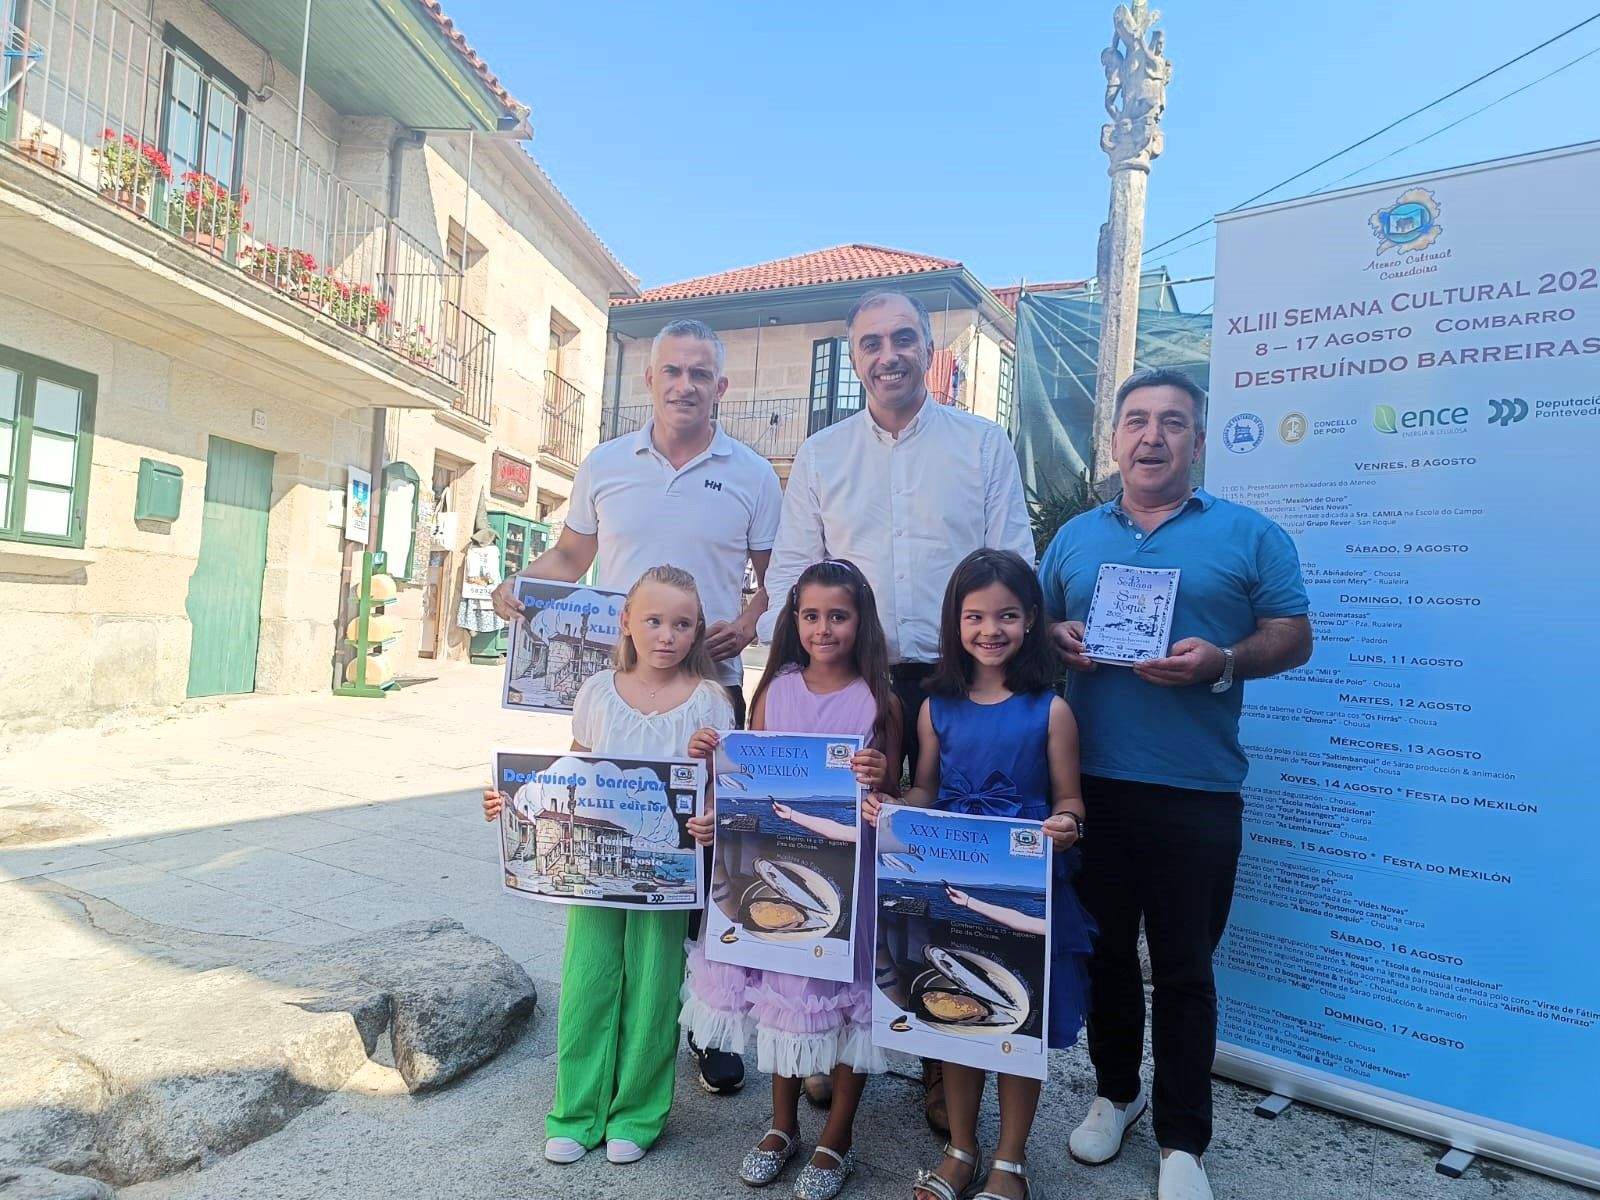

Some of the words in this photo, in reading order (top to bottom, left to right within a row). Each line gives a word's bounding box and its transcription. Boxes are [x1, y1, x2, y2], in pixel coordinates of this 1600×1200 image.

[1362, 260, 1401, 271] Ateneo
[1405, 249, 1452, 265] Cultural
[1379, 265, 1438, 281] Corredoira
[1227, 311, 1278, 335] XLIII
[1284, 300, 1384, 327] SEMANA
[1390, 280, 1531, 312] CULTURAL
[1537, 268, 1598, 294] 202
[1255, 343, 1268, 356] 8
[1296, 335, 1319, 350] 17
[1324, 326, 1412, 348] AGOSTO
[1435, 308, 1575, 333] COMBARRO
[1235, 355, 1408, 389] DESTRUÍNDO
[1417, 337, 1600, 368] BARREIRAS
[1535, 395, 1600, 411] Deputació
[1313, 418, 1357, 428] CONCELLO
[1401, 406, 1469, 428] ence
[1325, 427, 1346, 435] POIO
[1354, 461, 1408, 471] VENRES,
[1411, 459, 1420, 468] 8
[1423, 457, 1476, 467] AGOSTO
[704, 479, 722, 491] HH
[1372, 509, 1403, 517] CAMILA
[1415, 508, 1440, 516] Escola
[1403, 543, 1412, 552] 9
[1415, 543, 1469, 553] AGOSTO
[1116, 590, 1139, 602] San
[1340, 594, 1402, 605] DOMINGO,
[1407, 595, 1424, 605] 10
[1426, 597, 1481, 606] AGOSTO
[589, 624, 618, 634] XLII
[1349, 653, 1387, 664] LUNS,
[1391, 655, 1406, 665] 11
[1410, 657, 1464, 668] AGOSTO
[1339, 693, 1394, 706] MARTES,
[1399, 698, 1415, 708] 12
[1418, 700, 1472, 712] AGOSTO
[740, 745, 768, 757] XXX
[771, 747, 809, 759] FESTA
[1329, 736, 1402, 752] MÉRCORES,
[1408, 744, 1425, 754] 13
[1427, 747, 1482, 760] AGOSTO
[740, 763, 755, 774] DO
[758, 764, 809, 777] MEXILÓN
[595, 775, 668, 792] barreiras
[1280, 772, 1320, 786] XOVES,
[1322, 778, 1340, 788] 14
[1343, 782, 1393, 795] AGOSTO
[1405, 788, 1447, 803] FESTA
[1451, 795, 1470, 805] DO
[1473, 797, 1538, 813] MEXILÓN
[577, 797, 615, 809] XLIII
[909, 823, 940, 839] XXX
[945, 829, 990, 845] FESTA
[908, 843, 927, 856] DO
[929, 845, 990, 864] MEXILÓN
[1249, 832, 1296, 848] VENRES,
[1300, 841, 1316, 851] 15
[1318, 845, 1367, 860] AGOSTO
[1383, 855, 1423, 870] FESTA
[1426, 863, 1445, 873] DO
[1448, 866, 1512, 884] MEXILÓN
[1330, 930, 1386, 951] SÁBADO,
[1390, 942, 1407, 954] 16
[1410, 948, 1464, 966] AGOSTO
[1324, 1006, 1387, 1032] DOMINGO,
[1391, 1023, 1409, 1035] 17
[1411, 1030, 1465, 1050] AGOSTO
